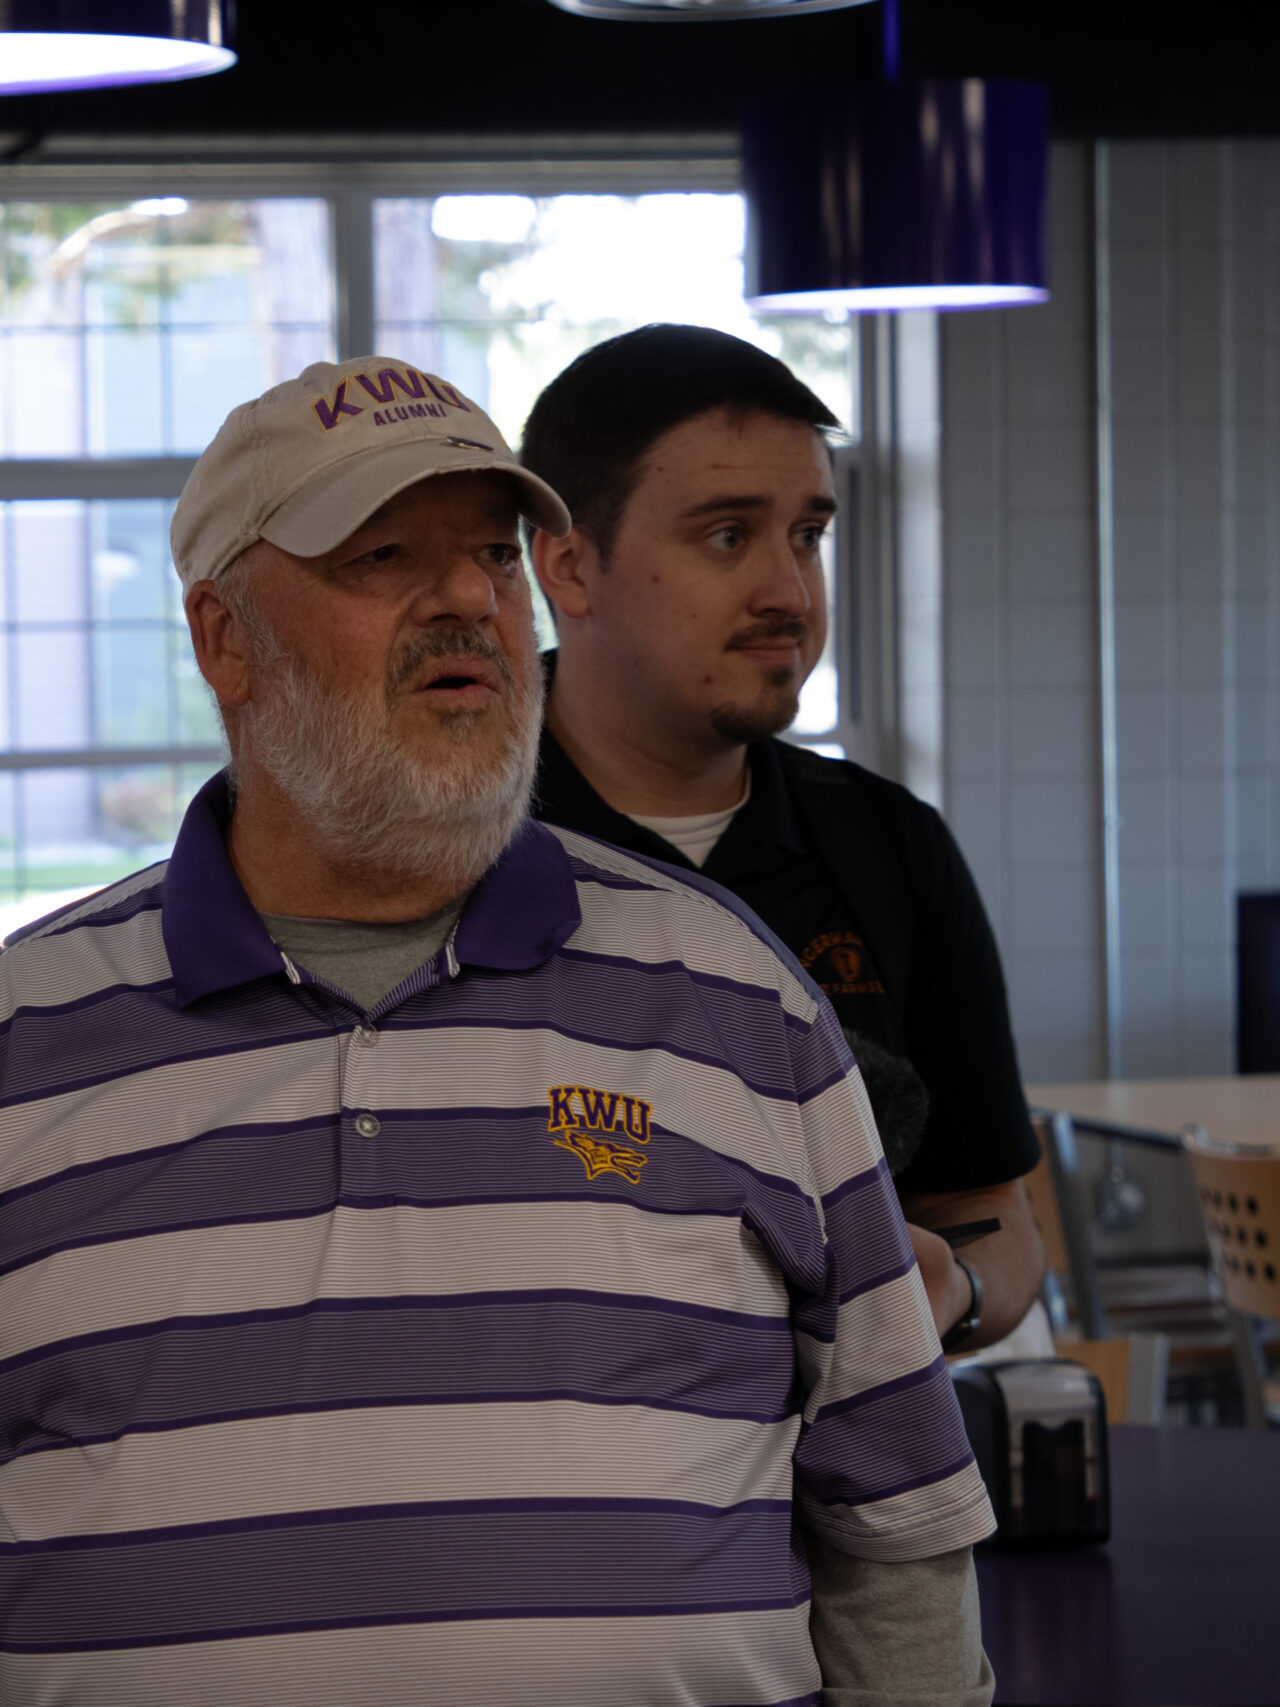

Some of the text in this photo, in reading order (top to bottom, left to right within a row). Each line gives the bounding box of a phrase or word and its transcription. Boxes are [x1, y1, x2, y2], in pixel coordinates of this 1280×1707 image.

[311, 368, 472, 433] KWU
[373, 403, 448, 427] ALUMNI
[547, 1085, 653, 1145] KWU
